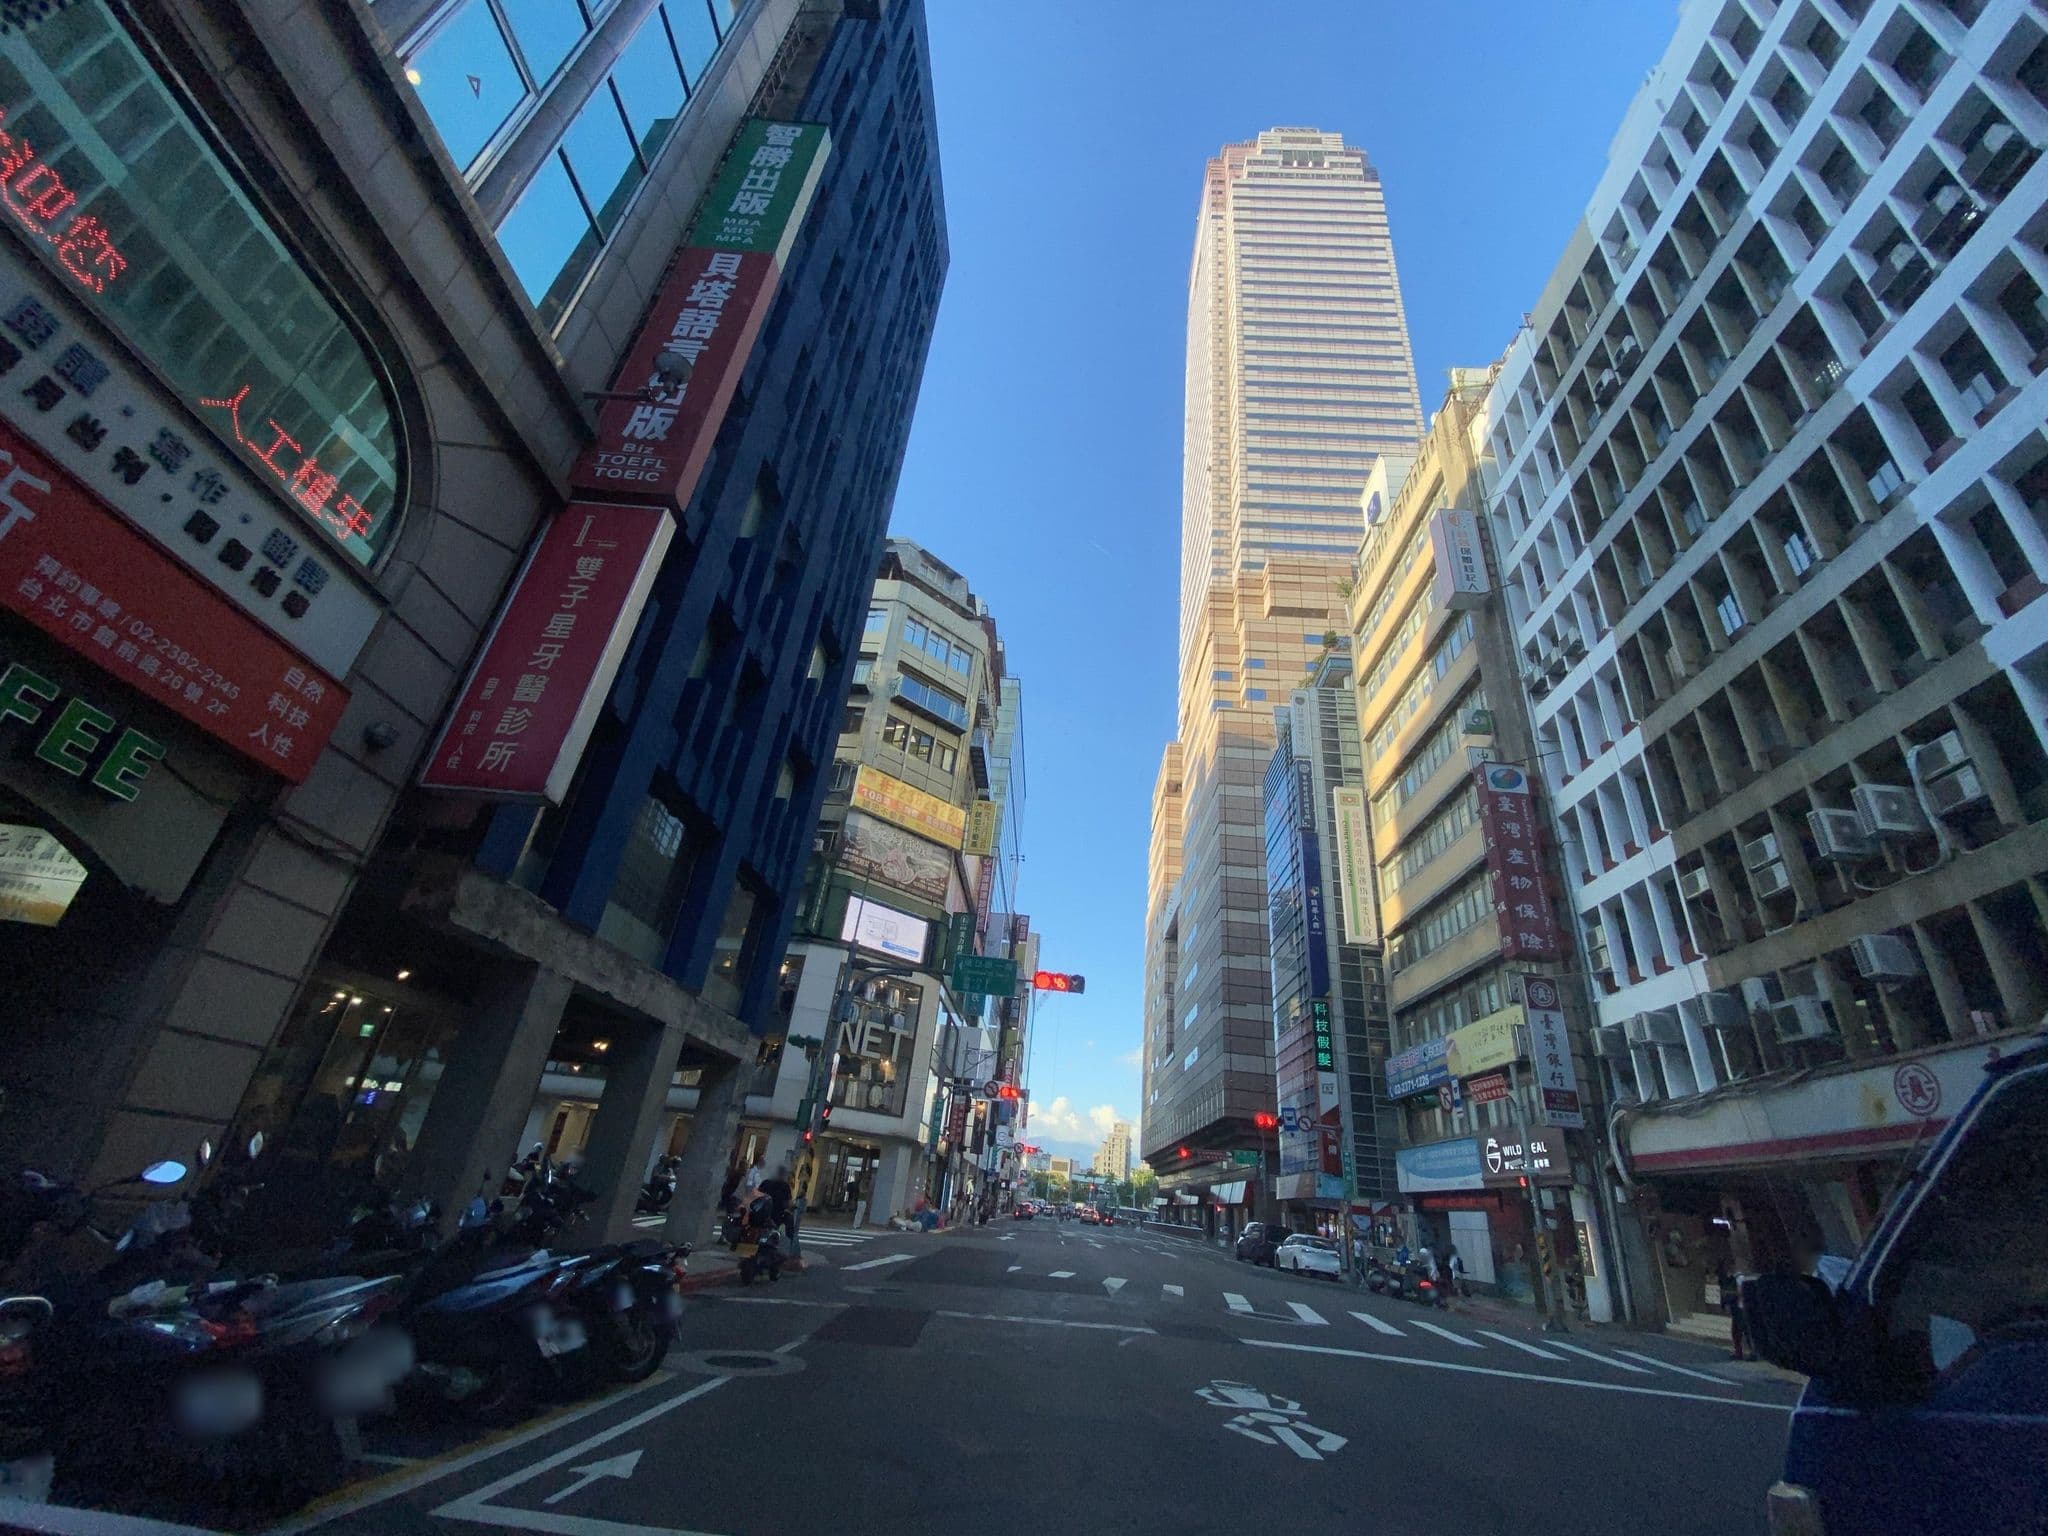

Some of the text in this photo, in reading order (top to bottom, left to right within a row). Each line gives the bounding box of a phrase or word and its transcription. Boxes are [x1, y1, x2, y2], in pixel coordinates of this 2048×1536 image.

[729, 124, 803, 216] 智勝出版
[0, 108, 128, 293] 迎您
[715, 234, 753, 245] MPA
[723, 217, 760, 227] MBA
[199, 384, 373, 540] 人工植牙
[599, 453, 668, 470] TOEFL
[622, 442, 655, 455] Biz
[594, 467, 660, 481] TOEIC
[130, 619, 241, 700] 02-2382-2345
[477, 555, 605, 773] 雙子星牙醫診所
[283, 666, 326, 704] 自然
[267, 692, 311, 728] 科技
[249, 723, 296, 759] 人性
[1497, 795, 1544, 950] 臺灣產物保險
[837, 1021, 914, 1063] NET
[1314, 1003, 1332, 1067] 科技假髮
[1540, 1013, 1565, 1087] 臺灣銀行
[1502, 1141, 1548, 1157] WILD EAL
